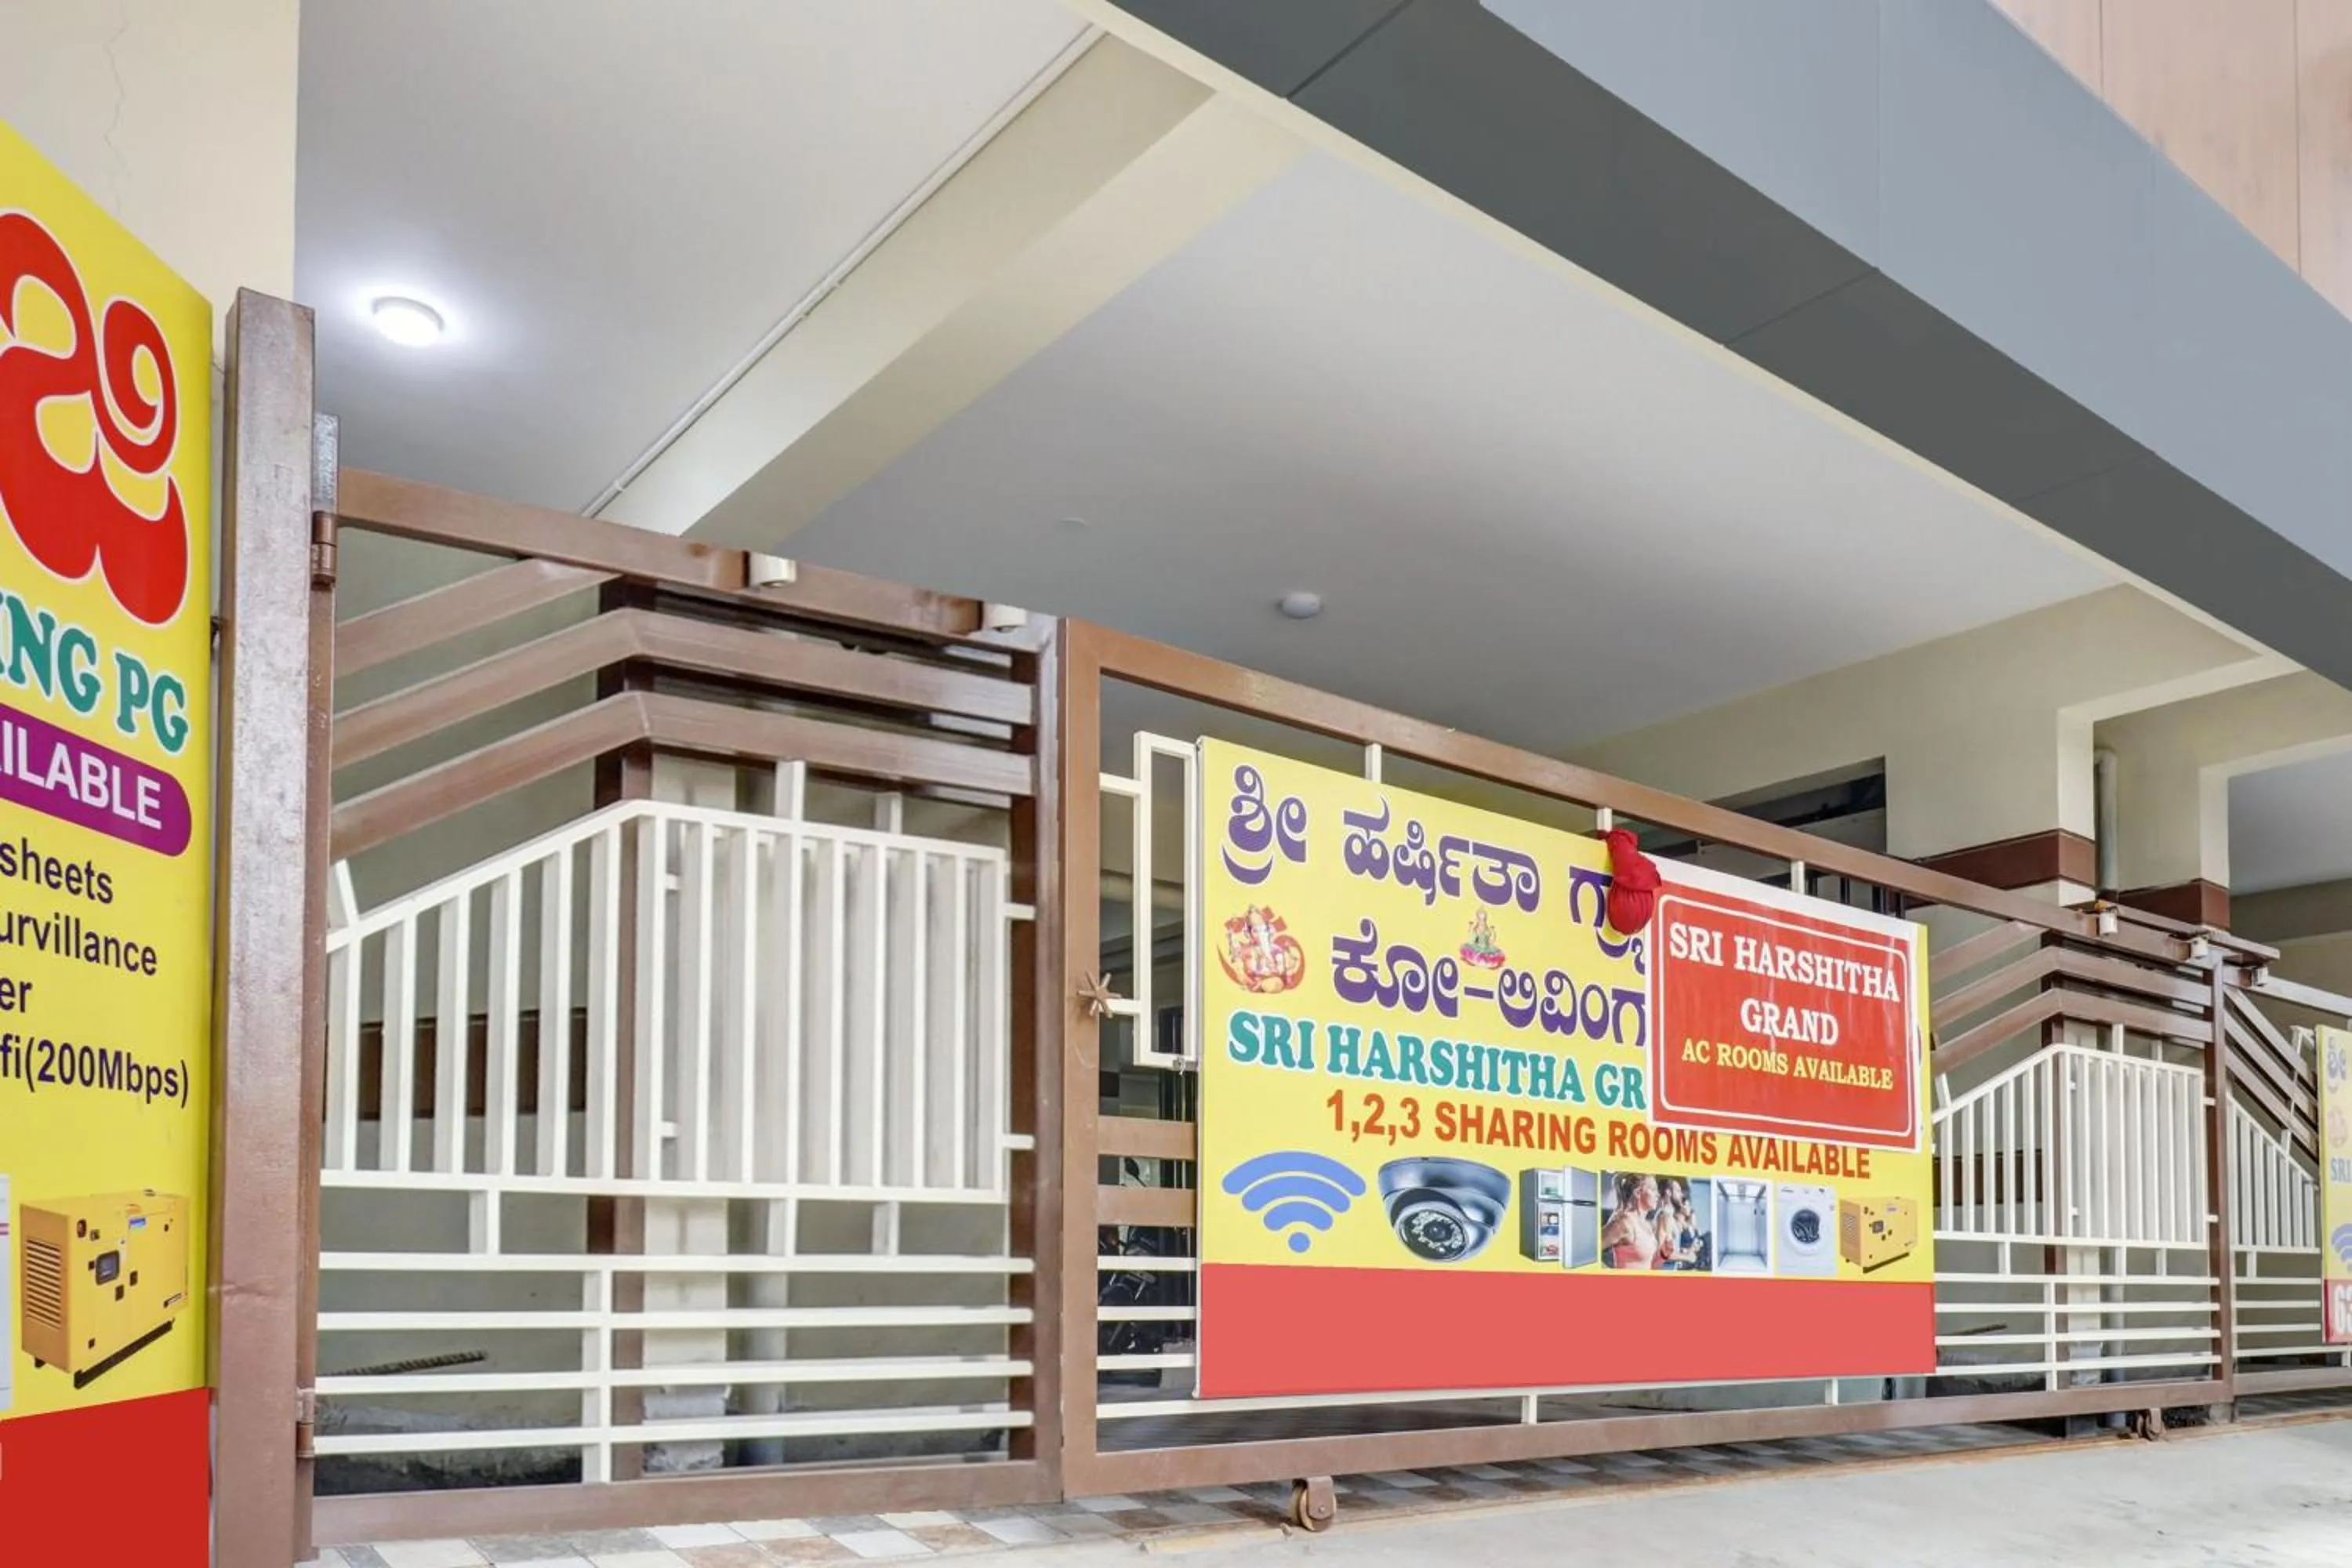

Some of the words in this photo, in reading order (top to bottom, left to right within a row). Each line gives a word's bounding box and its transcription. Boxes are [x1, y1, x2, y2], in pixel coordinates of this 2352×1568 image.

[117, 652, 189, 753] PG
[0, 720, 162, 829] ILABLE
[0, 837, 113, 903] sheets
[1222, 764, 1307, 885] ಶ್ರೀ
[1343, 794, 1541, 913] ಹರ್ಷಿತಾ
[1670, 923, 1724, 967] SRI
[1733, 935, 1900, 1003] HARSHITHA
[1228, 1011, 1316, 1070] SRI
[1327, 1025, 1586, 1104] HARSHITHA
[1682, 1038, 1710, 1064] AC
[1716, 1045, 1789, 1076] ROOMS
[1792, 1057, 1894, 1091] AVAILABLE
[1740, 997, 1838, 1046] GRAND
[1327, 1089, 1421, 1146] 1,2,3
[1434, 1101, 1596, 1155] SHARING
[1608, 1121, 1718, 1165] ROOMS
[1727, 1134, 1871, 1179] AVAILABLE
